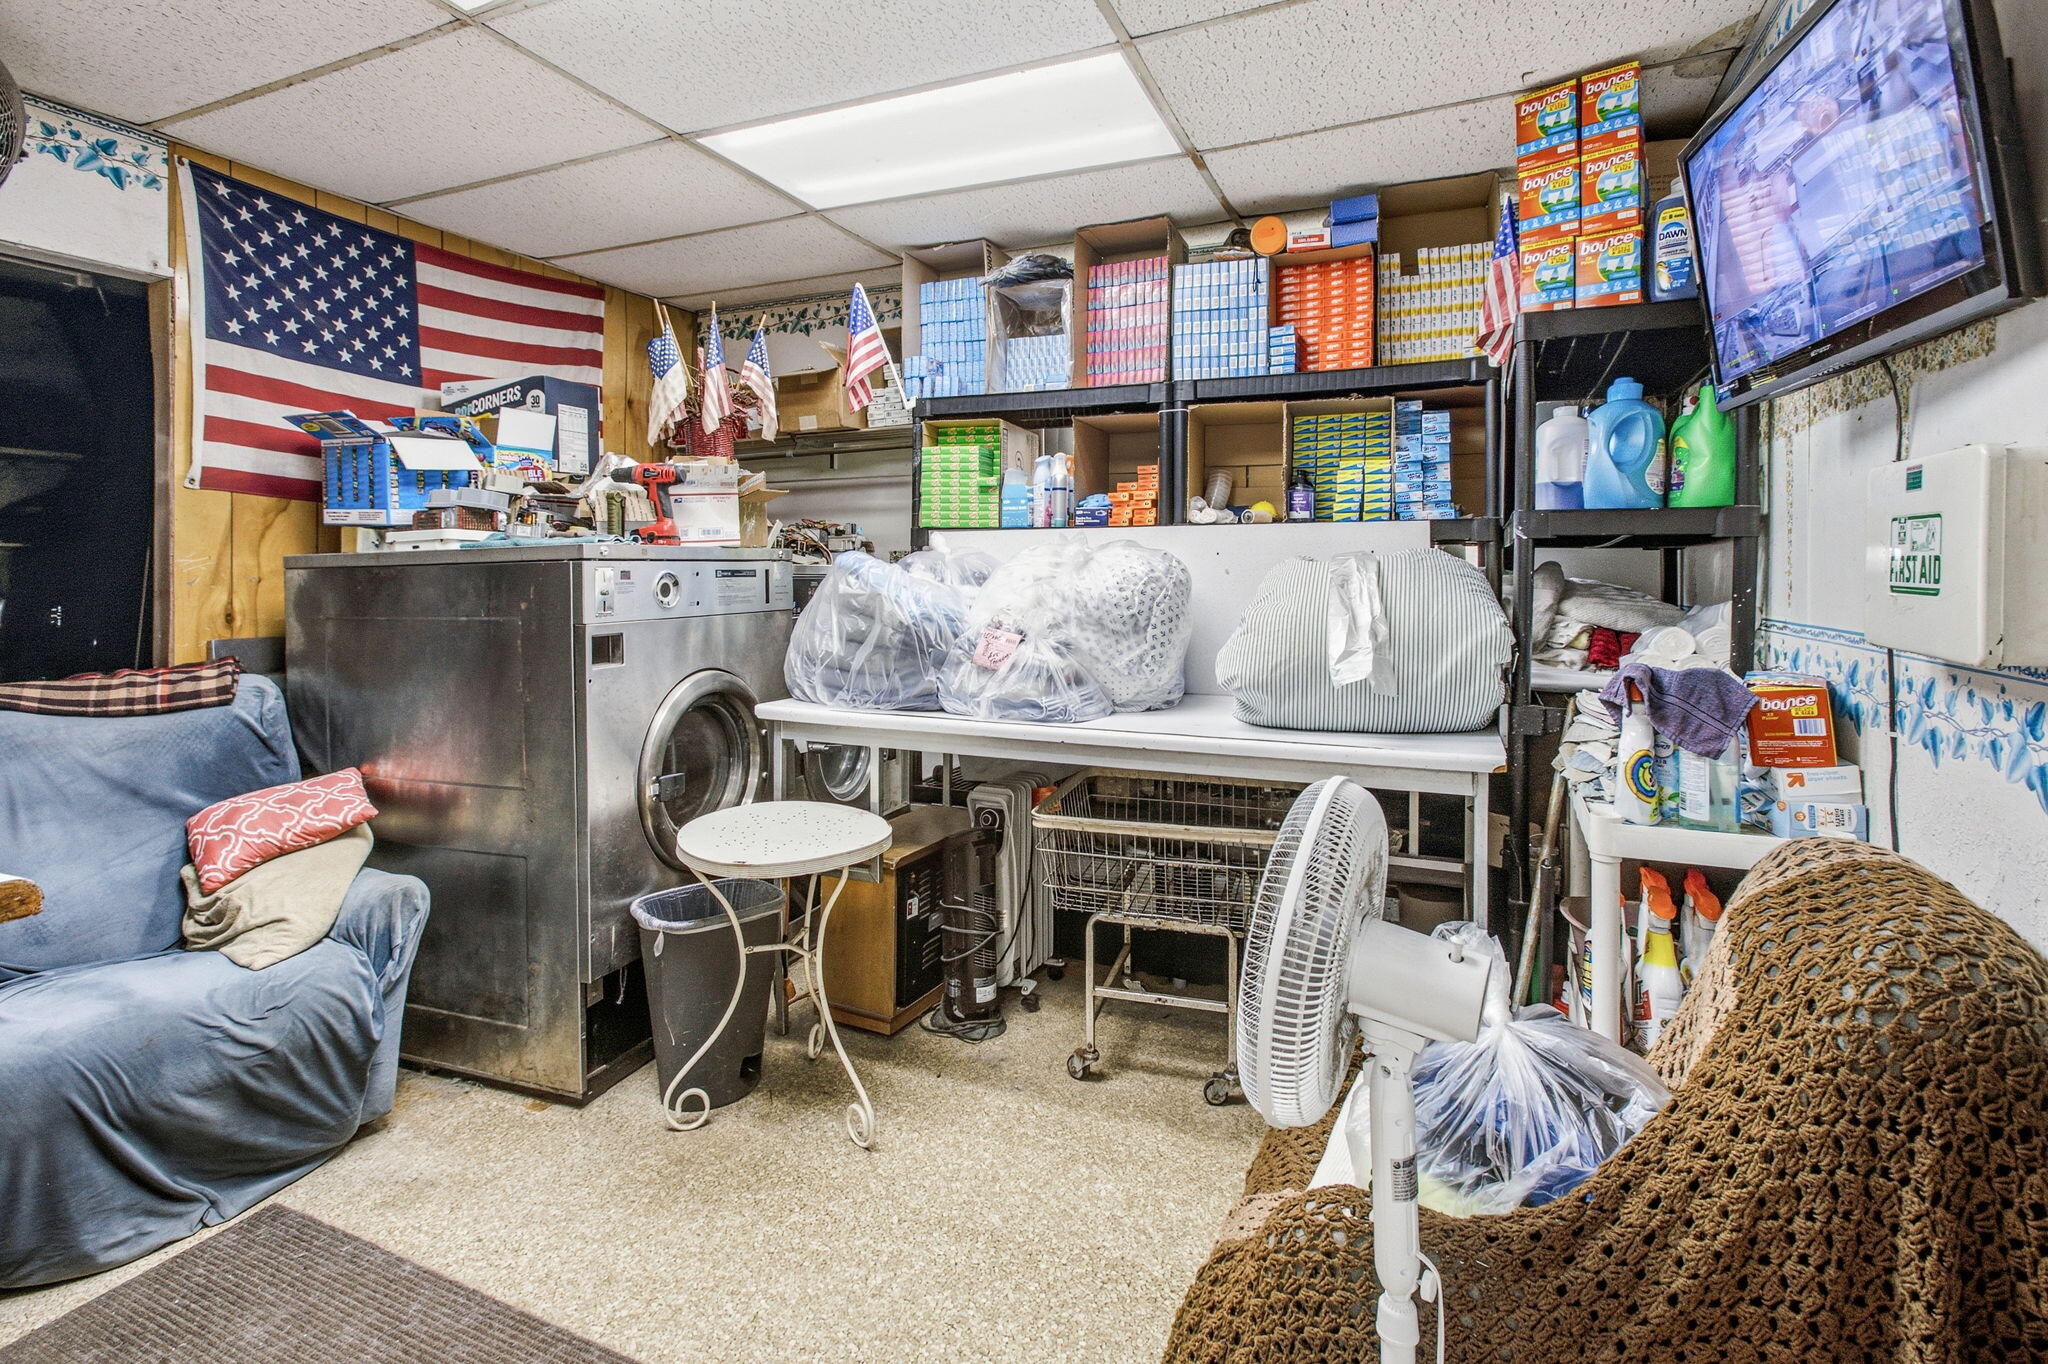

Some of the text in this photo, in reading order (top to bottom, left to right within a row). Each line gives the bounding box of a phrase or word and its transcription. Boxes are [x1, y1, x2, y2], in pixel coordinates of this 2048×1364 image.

[1586, 70, 1635, 95] bounce
[1520, 88, 1570, 116] bounce
[1585, 151, 1635, 175] bounce
[1523, 166, 1573, 191] bounce
[1580, 232, 1635, 256] bounce
[1658, 228, 1688, 241] DAWN
[1523, 244, 1570, 265] bounce
[530, 395, 540, 405] 30
[1919, 555, 1940, 584] AID
[1760, 694, 1818, 711] bounce
